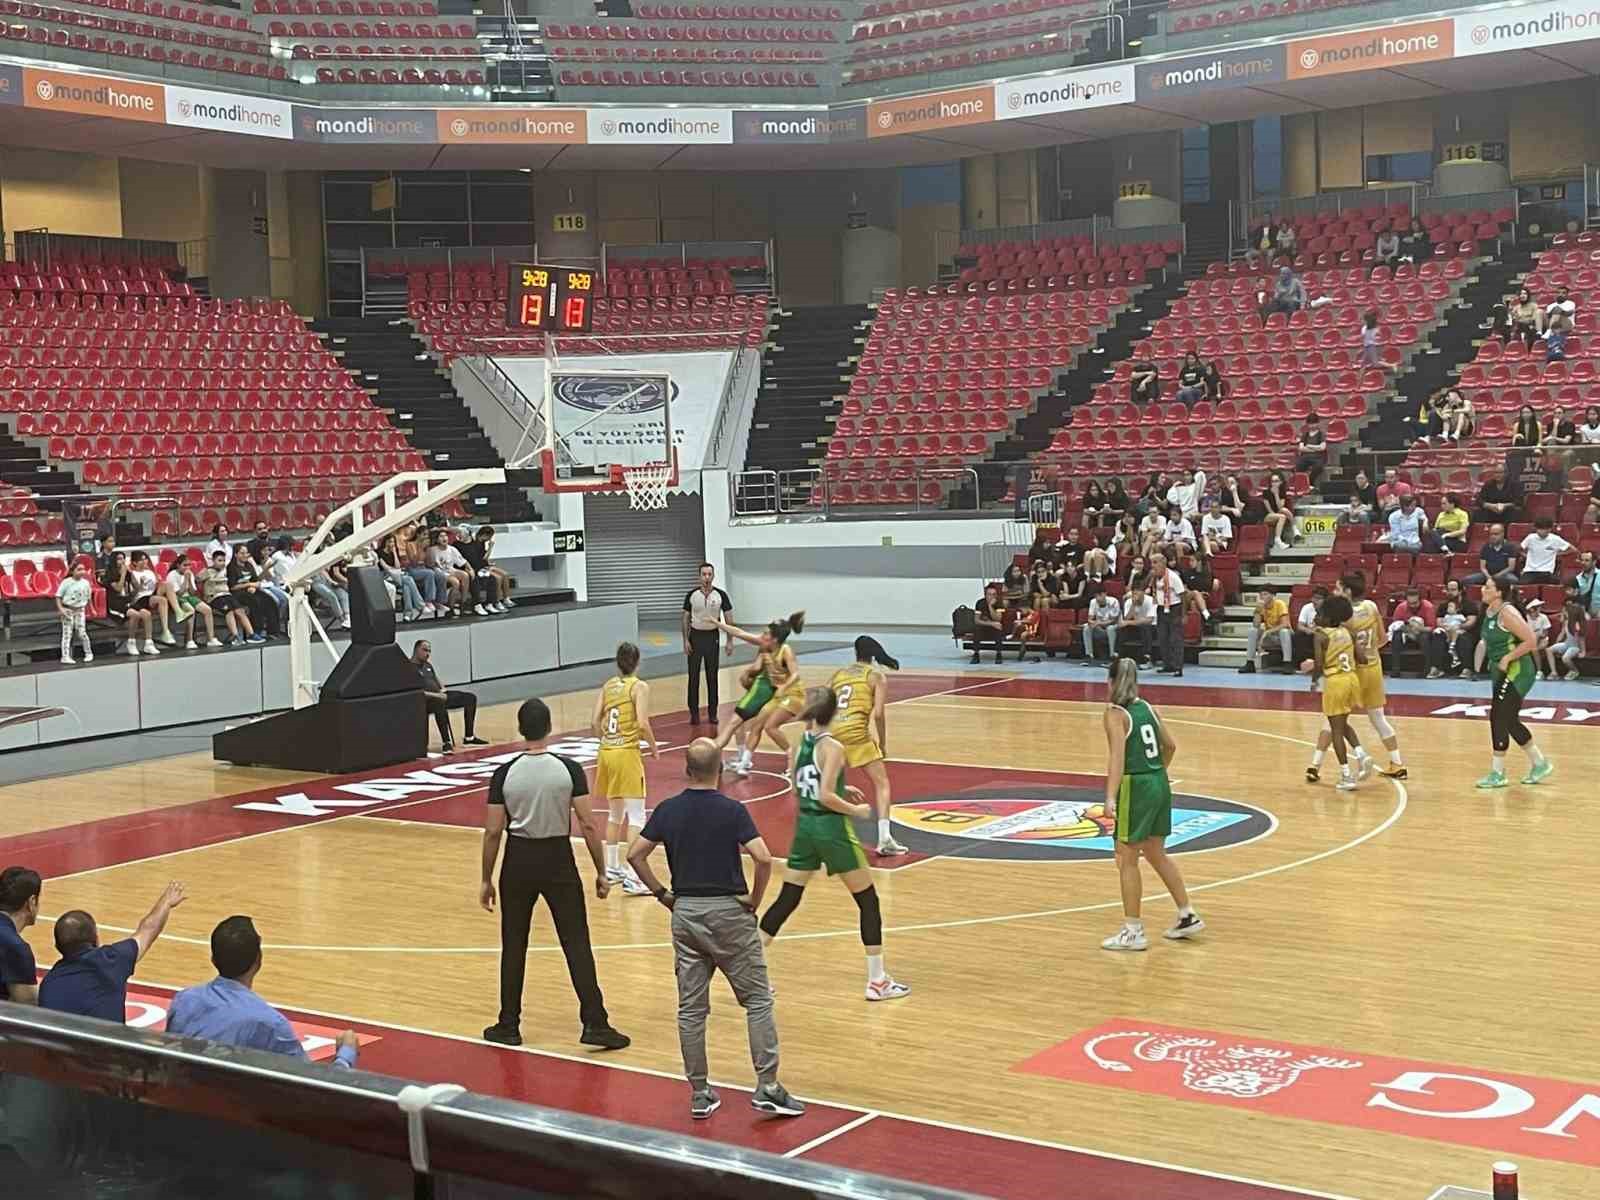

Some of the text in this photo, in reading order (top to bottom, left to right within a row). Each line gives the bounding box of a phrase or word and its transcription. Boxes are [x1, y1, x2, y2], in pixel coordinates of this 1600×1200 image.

[1320, 33, 1439, 64] mondihome
[1165, 57, 1273, 86] mondihome
[54, 86, 154, 111] mondihome
[1024, 79, 1122, 105] mondihome
[194, 102, 281, 128] mondihome
[893, 99, 984, 125] mondihome
[316, 117, 423, 134] mondihome
[470, 118, 575, 134] mondihome
[618, 118, 720, 134] mondihome
[762, 118, 857, 134] mondihome
[1446, 145, 1477, 160] 116
[1120, 183, 1148, 197] 117
[557, 216, 584, 229] 118
[521, 294, 542, 326] 13
[565, 298, 585, 328] 13
[1305, 521, 1326, 532] 016
[1338, 653, 1352, 672] 3
[838, 684, 853, 709] 2
[608, 707, 619, 734] 6
[1140, 724, 1159, 759] 9
